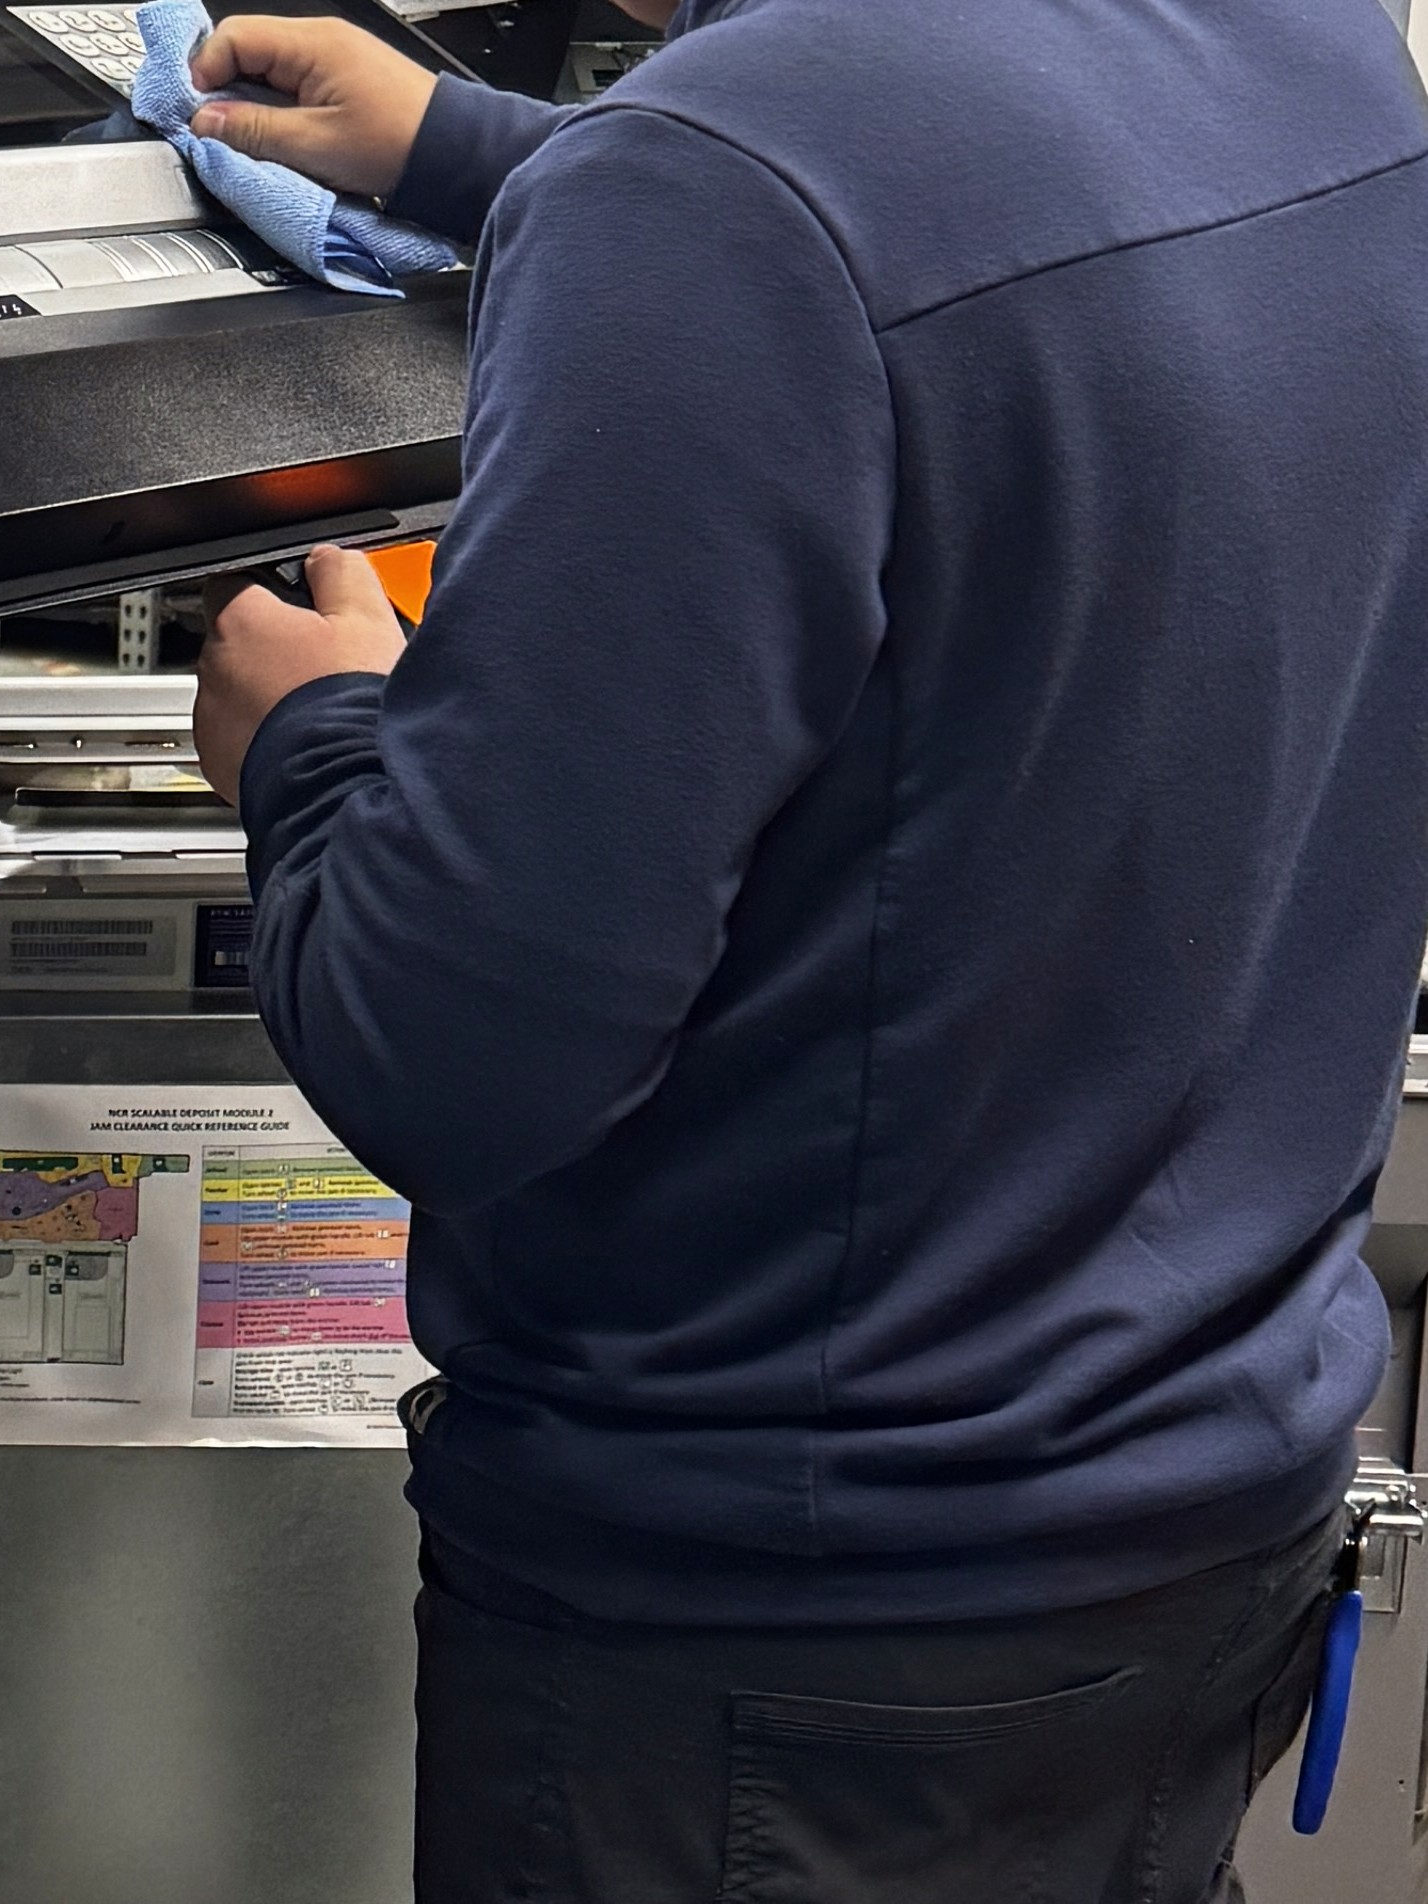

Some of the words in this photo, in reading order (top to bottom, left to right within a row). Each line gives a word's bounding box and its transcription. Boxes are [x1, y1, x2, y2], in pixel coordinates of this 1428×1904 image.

[108, 1109, 129, 1118] NCR
[130, 1109, 177, 1118] SCALABLE
[180, 1109, 221, 1118] DEPOSIT
[223, 1109, 266, 1118] MODULE
[90, 1122, 112, 1131] JAM
[113, 1122, 169, 1131] CLEARANCE
[171, 1122, 203, 1132] QUICK
[204, 1122, 258, 1131] REFERENCE
[260, 1122, 290, 1131] GUIDE
